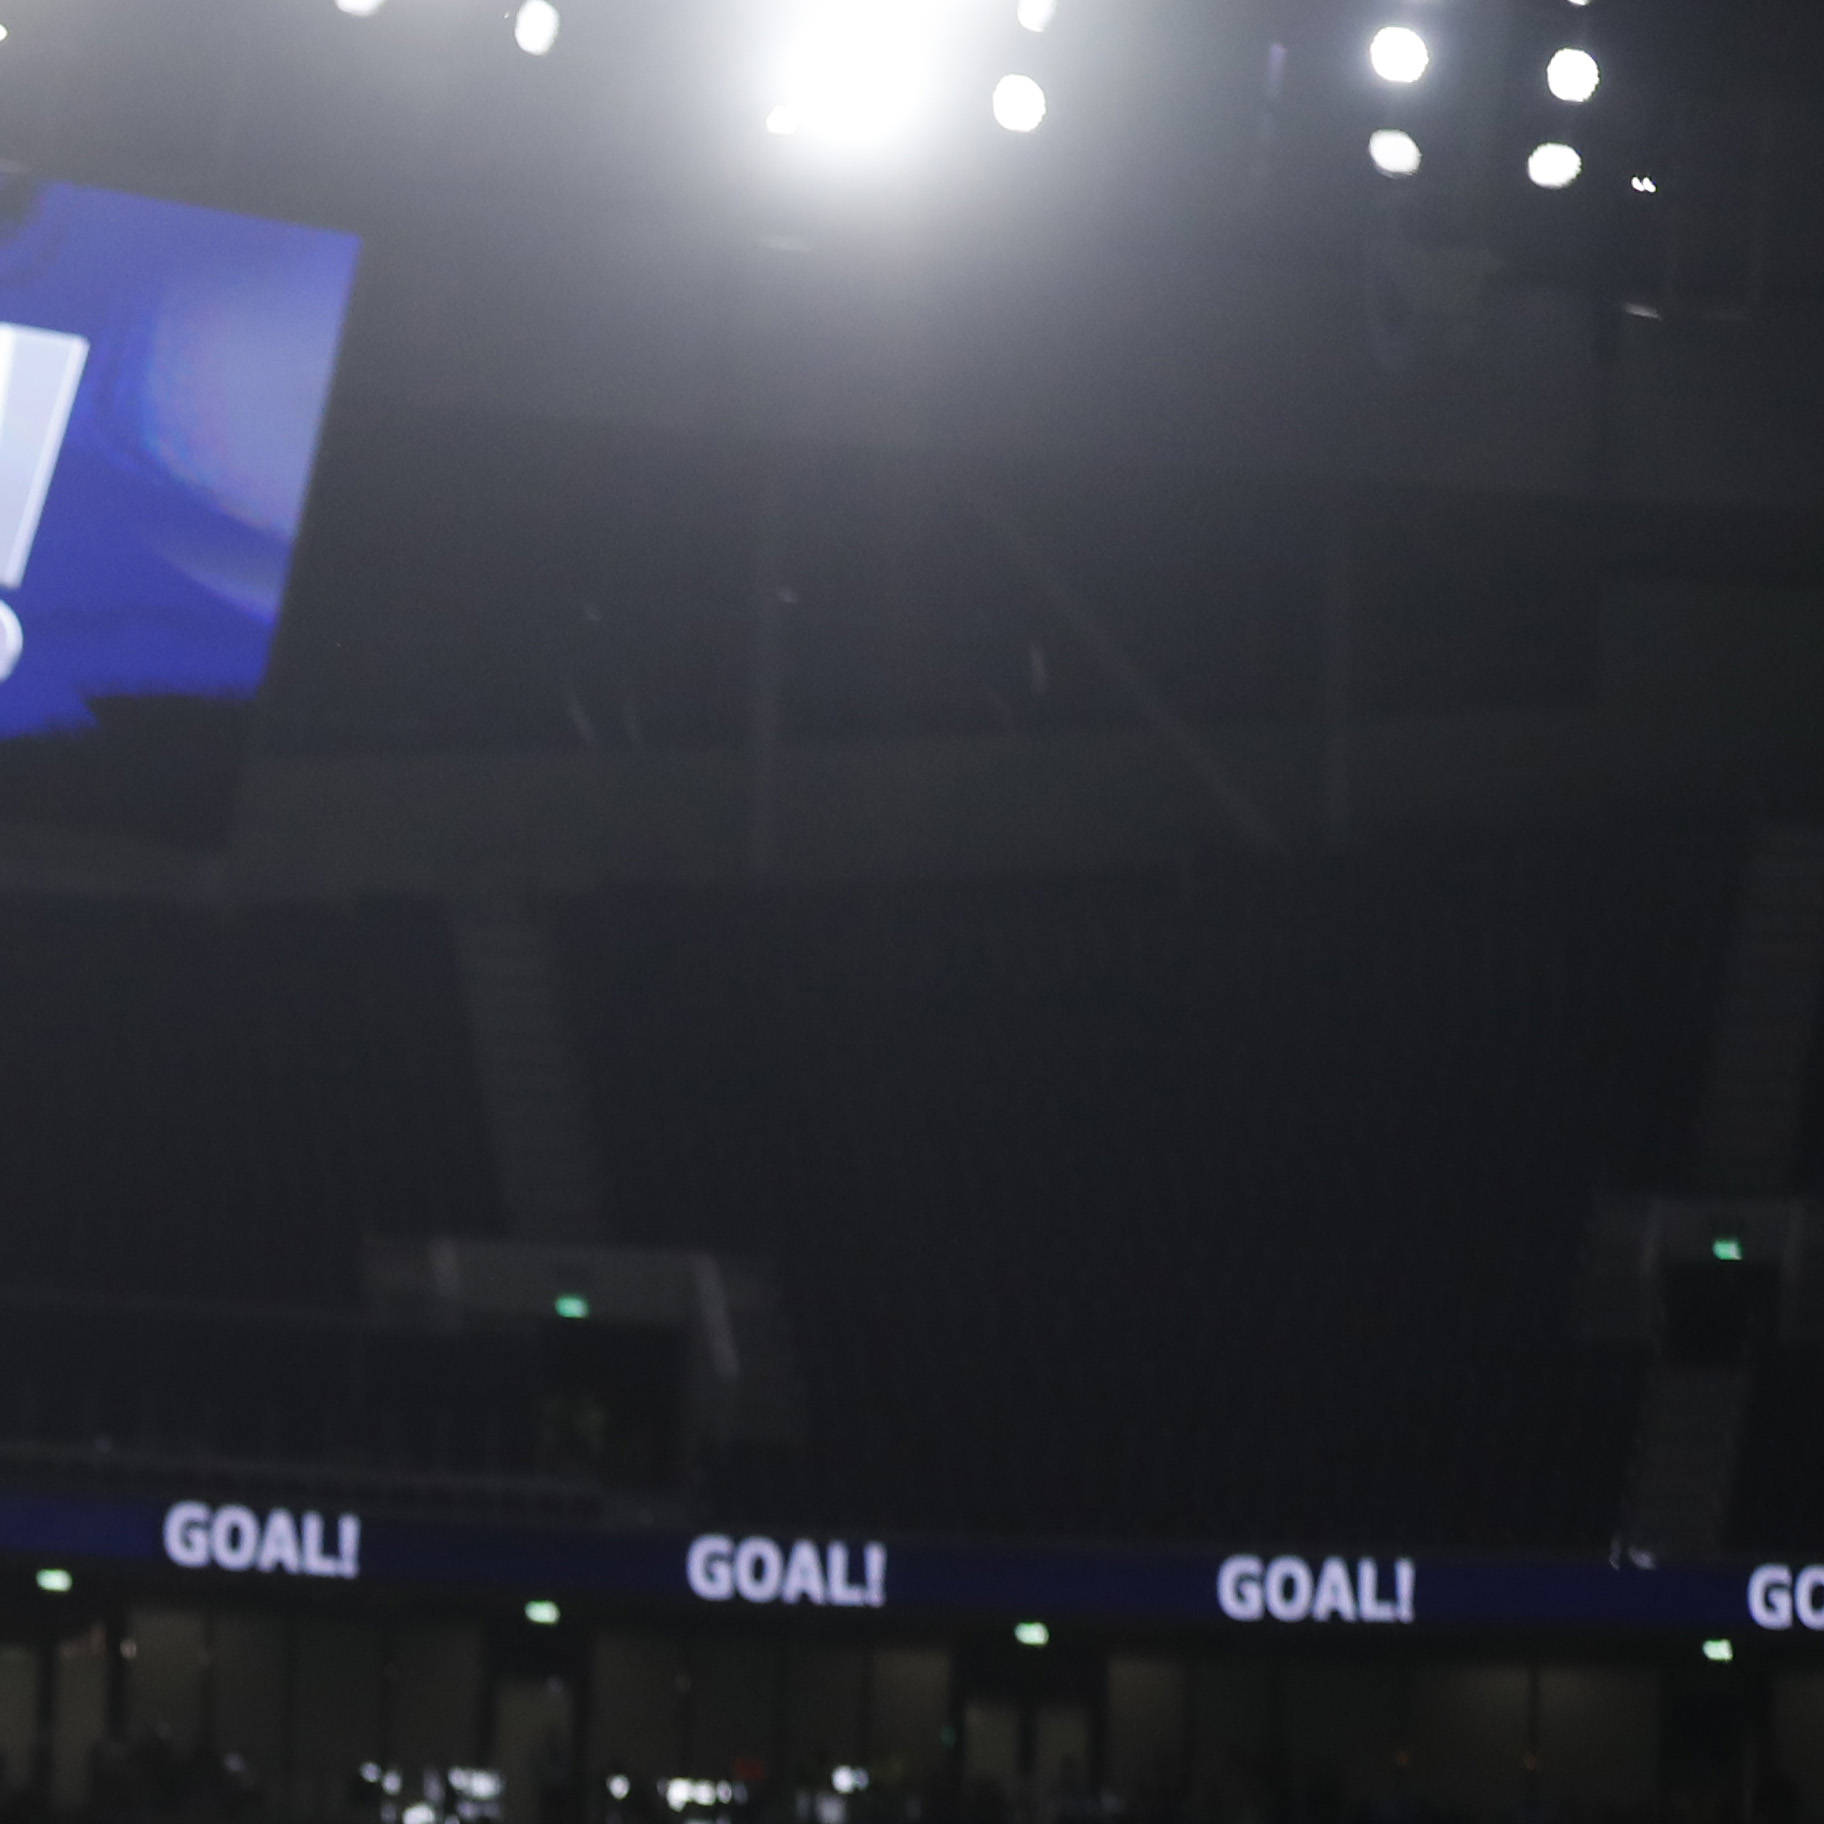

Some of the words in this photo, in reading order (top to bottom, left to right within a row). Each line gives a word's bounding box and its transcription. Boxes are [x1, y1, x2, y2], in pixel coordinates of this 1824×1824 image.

[165, 1502, 358, 1577] GOAL!
[688, 1535, 885, 1606] GOAL!
[1219, 1556, 1414, 1622] GOAL!
